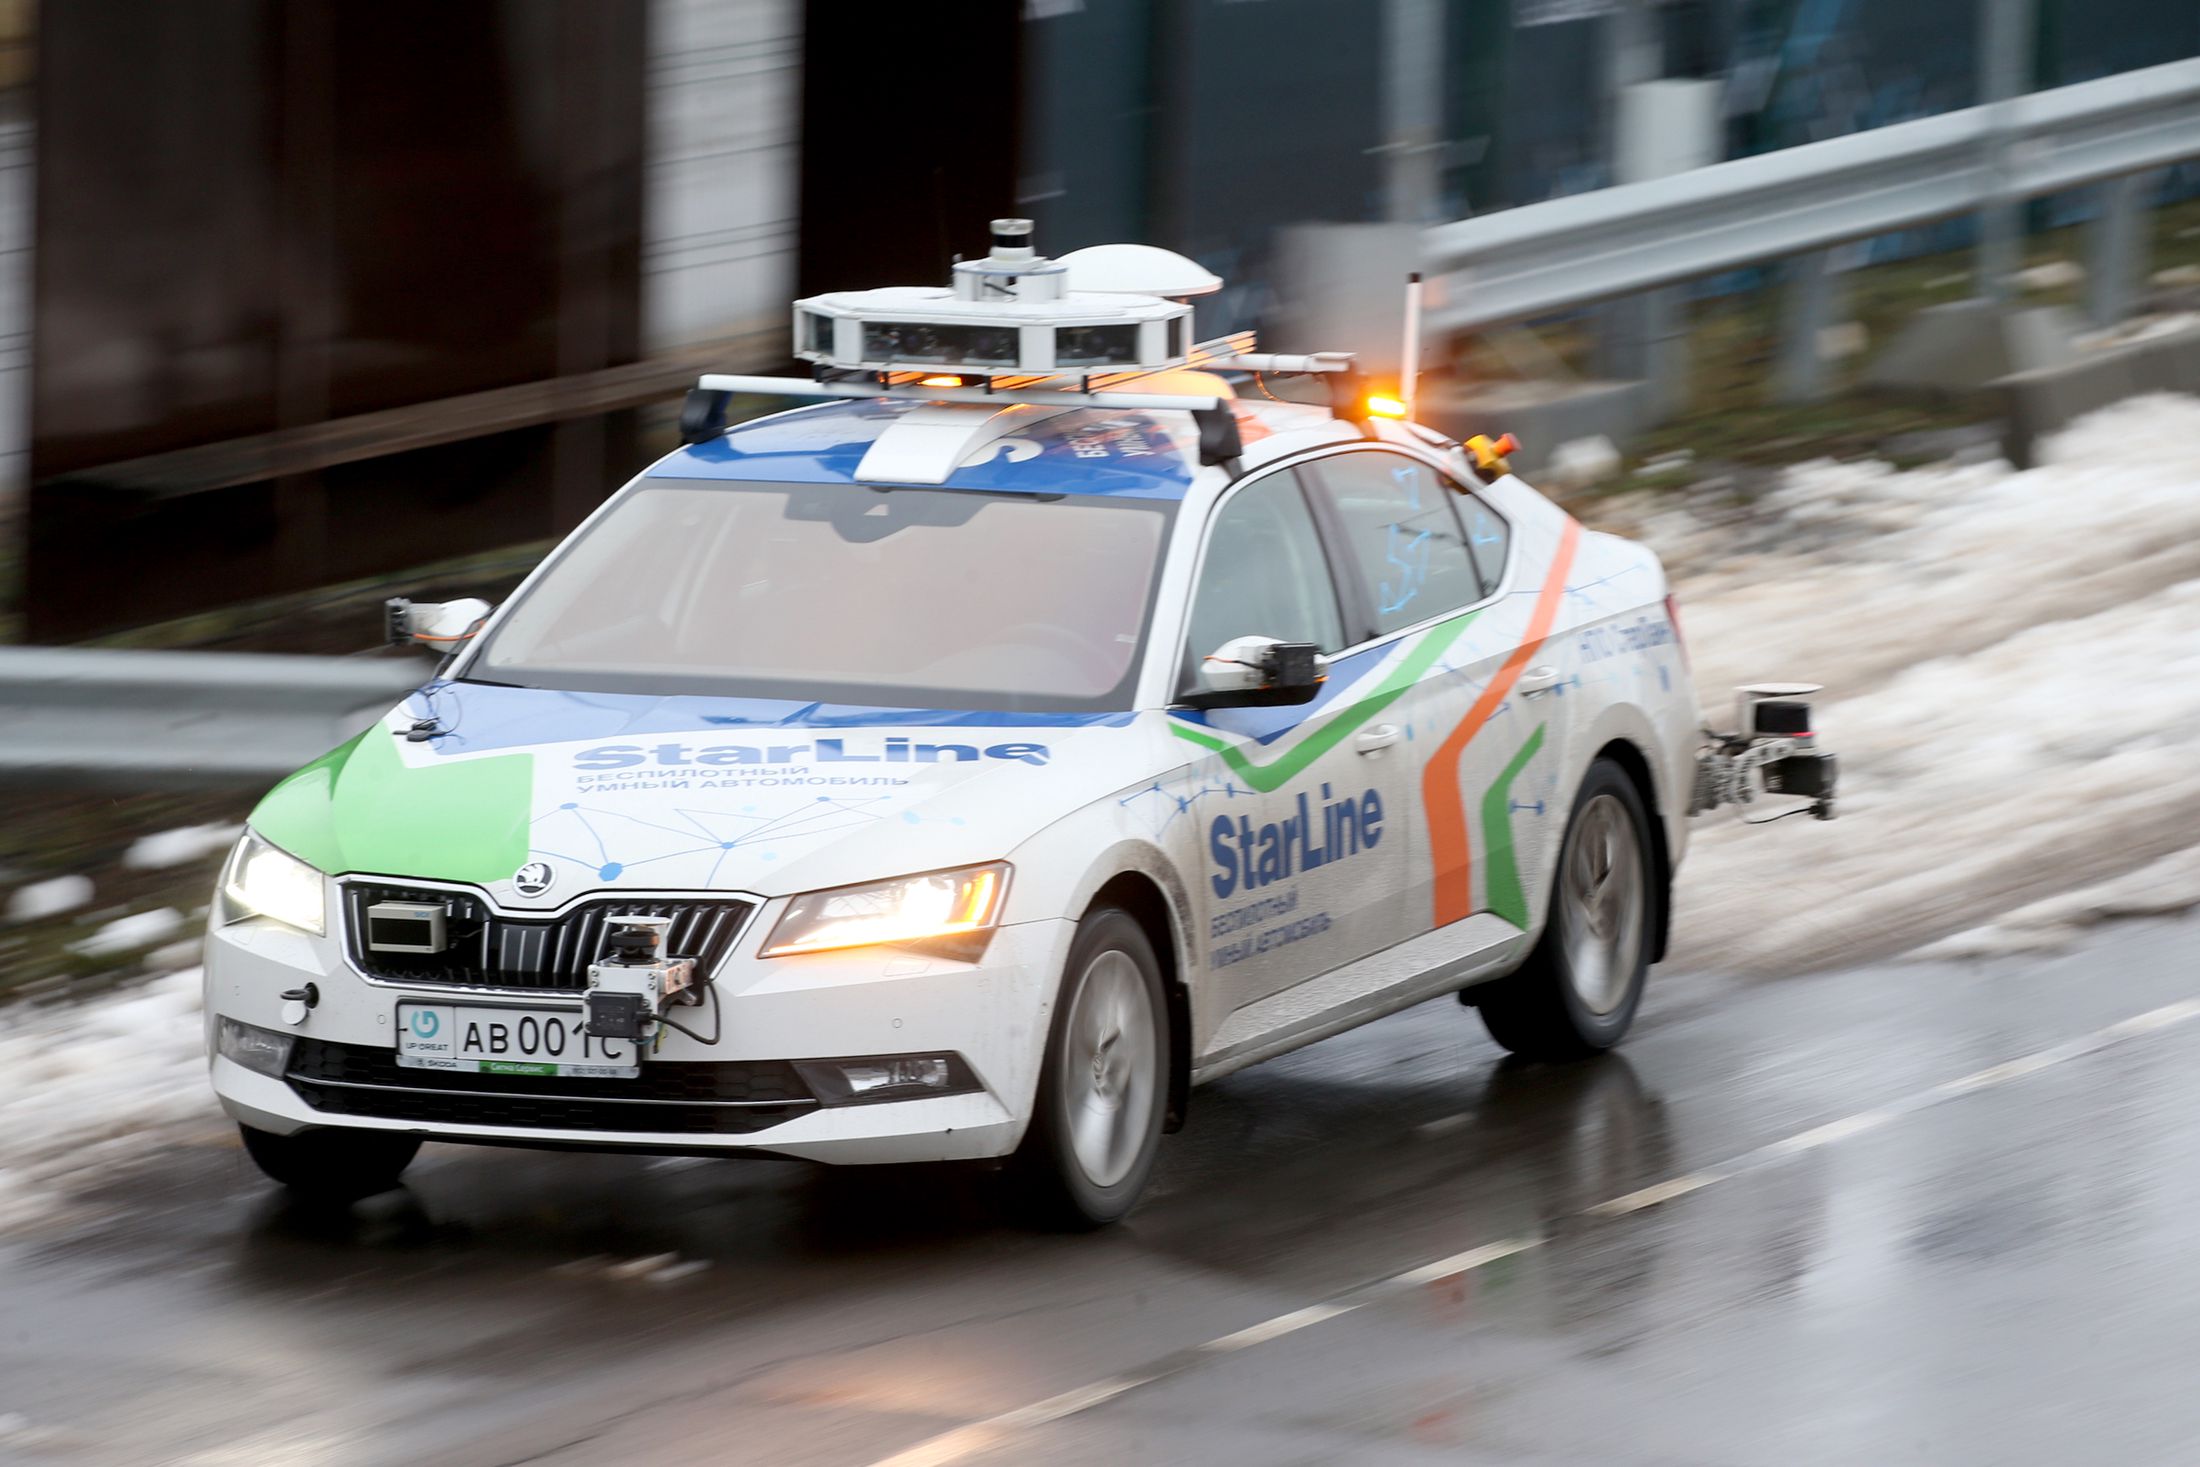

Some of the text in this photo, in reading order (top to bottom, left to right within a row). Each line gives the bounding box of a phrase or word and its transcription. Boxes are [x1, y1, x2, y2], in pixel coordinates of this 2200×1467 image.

[573, 737, 1051, 770] StarLine
[576, 766, 810, 784] БЕСПИЛОТНЫЙ
[576, 776, 910, 794] УМНЫЙ АВТОМОБИЛЬ
[1209, 782, 1385, 899] StarLine
